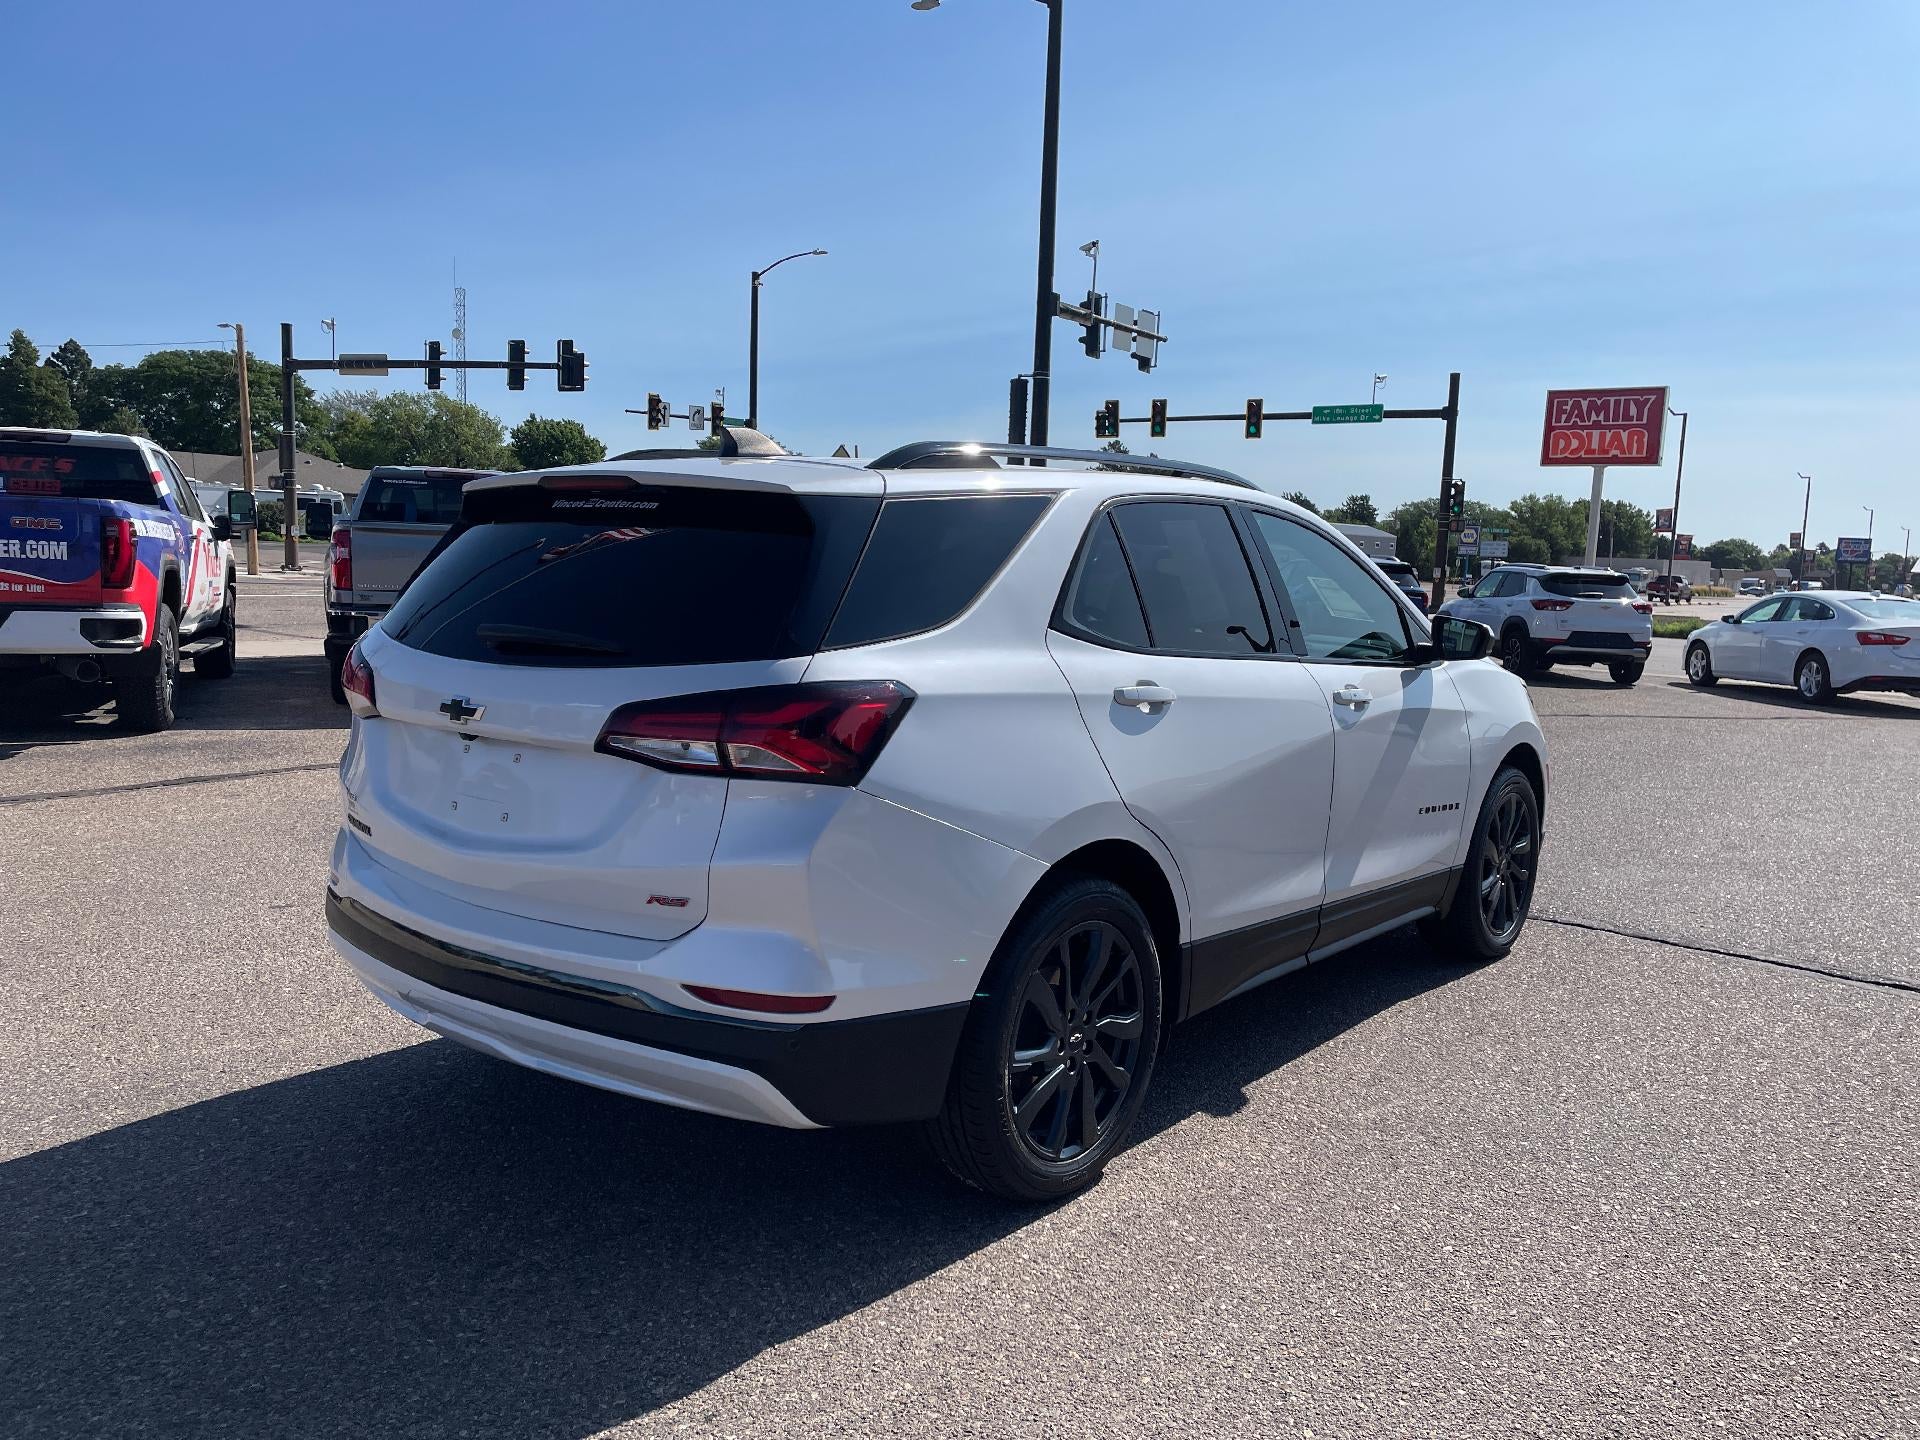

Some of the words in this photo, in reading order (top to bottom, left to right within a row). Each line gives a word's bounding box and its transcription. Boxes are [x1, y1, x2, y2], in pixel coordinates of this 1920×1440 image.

[1552, 395, 1656, 426] FAMILY
[1549, 428, 1648, 458] DOLLAR
[11, 516, 63, 530] GMC
[11, 583, 24, 592] for
[27, 583, 45, 593] Life!
[645, 894, 691, 908] RS
